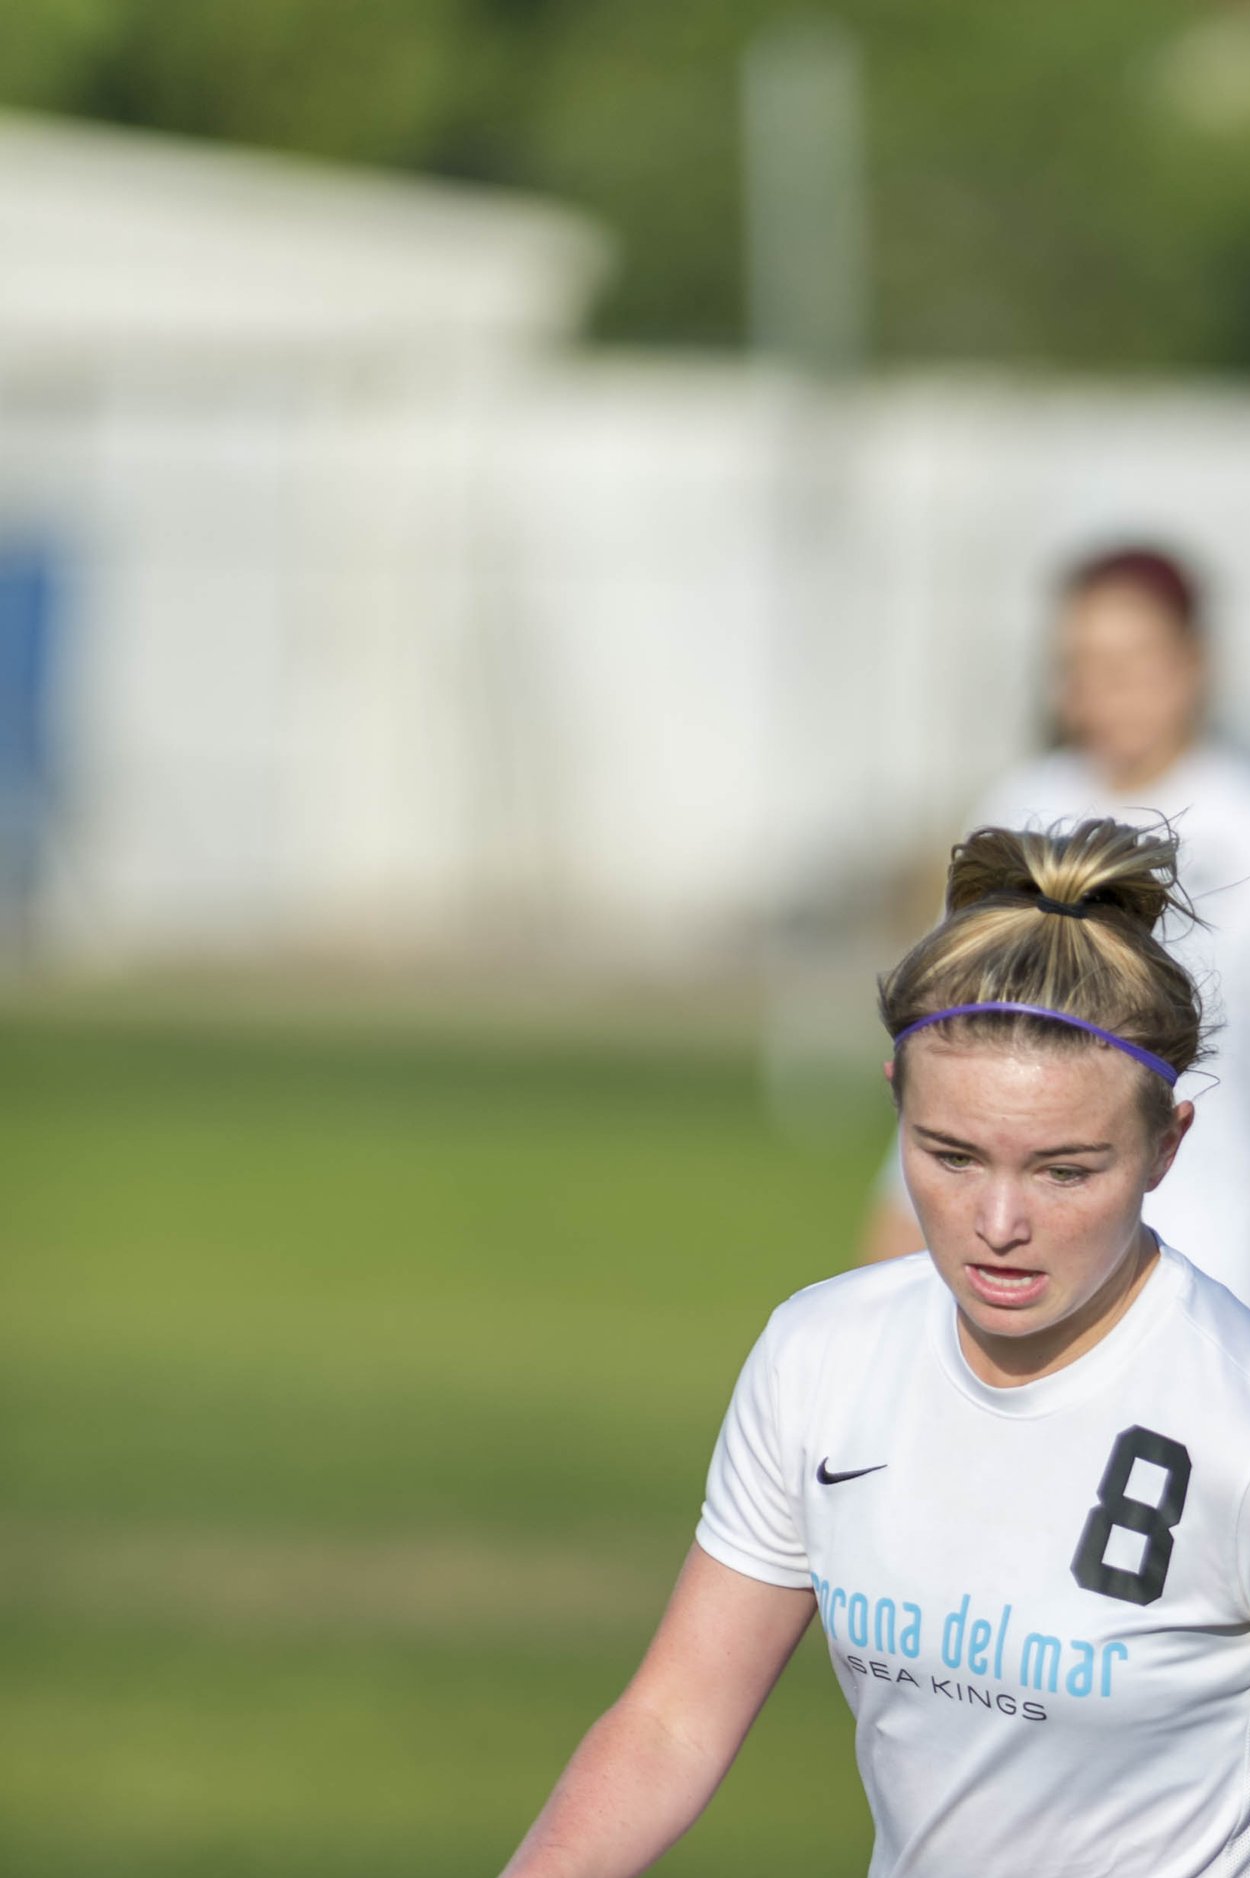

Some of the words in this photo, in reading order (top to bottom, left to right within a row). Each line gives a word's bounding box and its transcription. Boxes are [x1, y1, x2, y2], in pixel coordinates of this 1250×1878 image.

[1070, 1424, 1192, 1607] 8
[811, 1572, 922, 1659] orona
[942, 1593, 1012, 1680] del
[1020, 1631, 1128, 1698] mar
[847, 1655, 919, 1688] SEA
[931, 1676, 1048, 1721] KINGS
